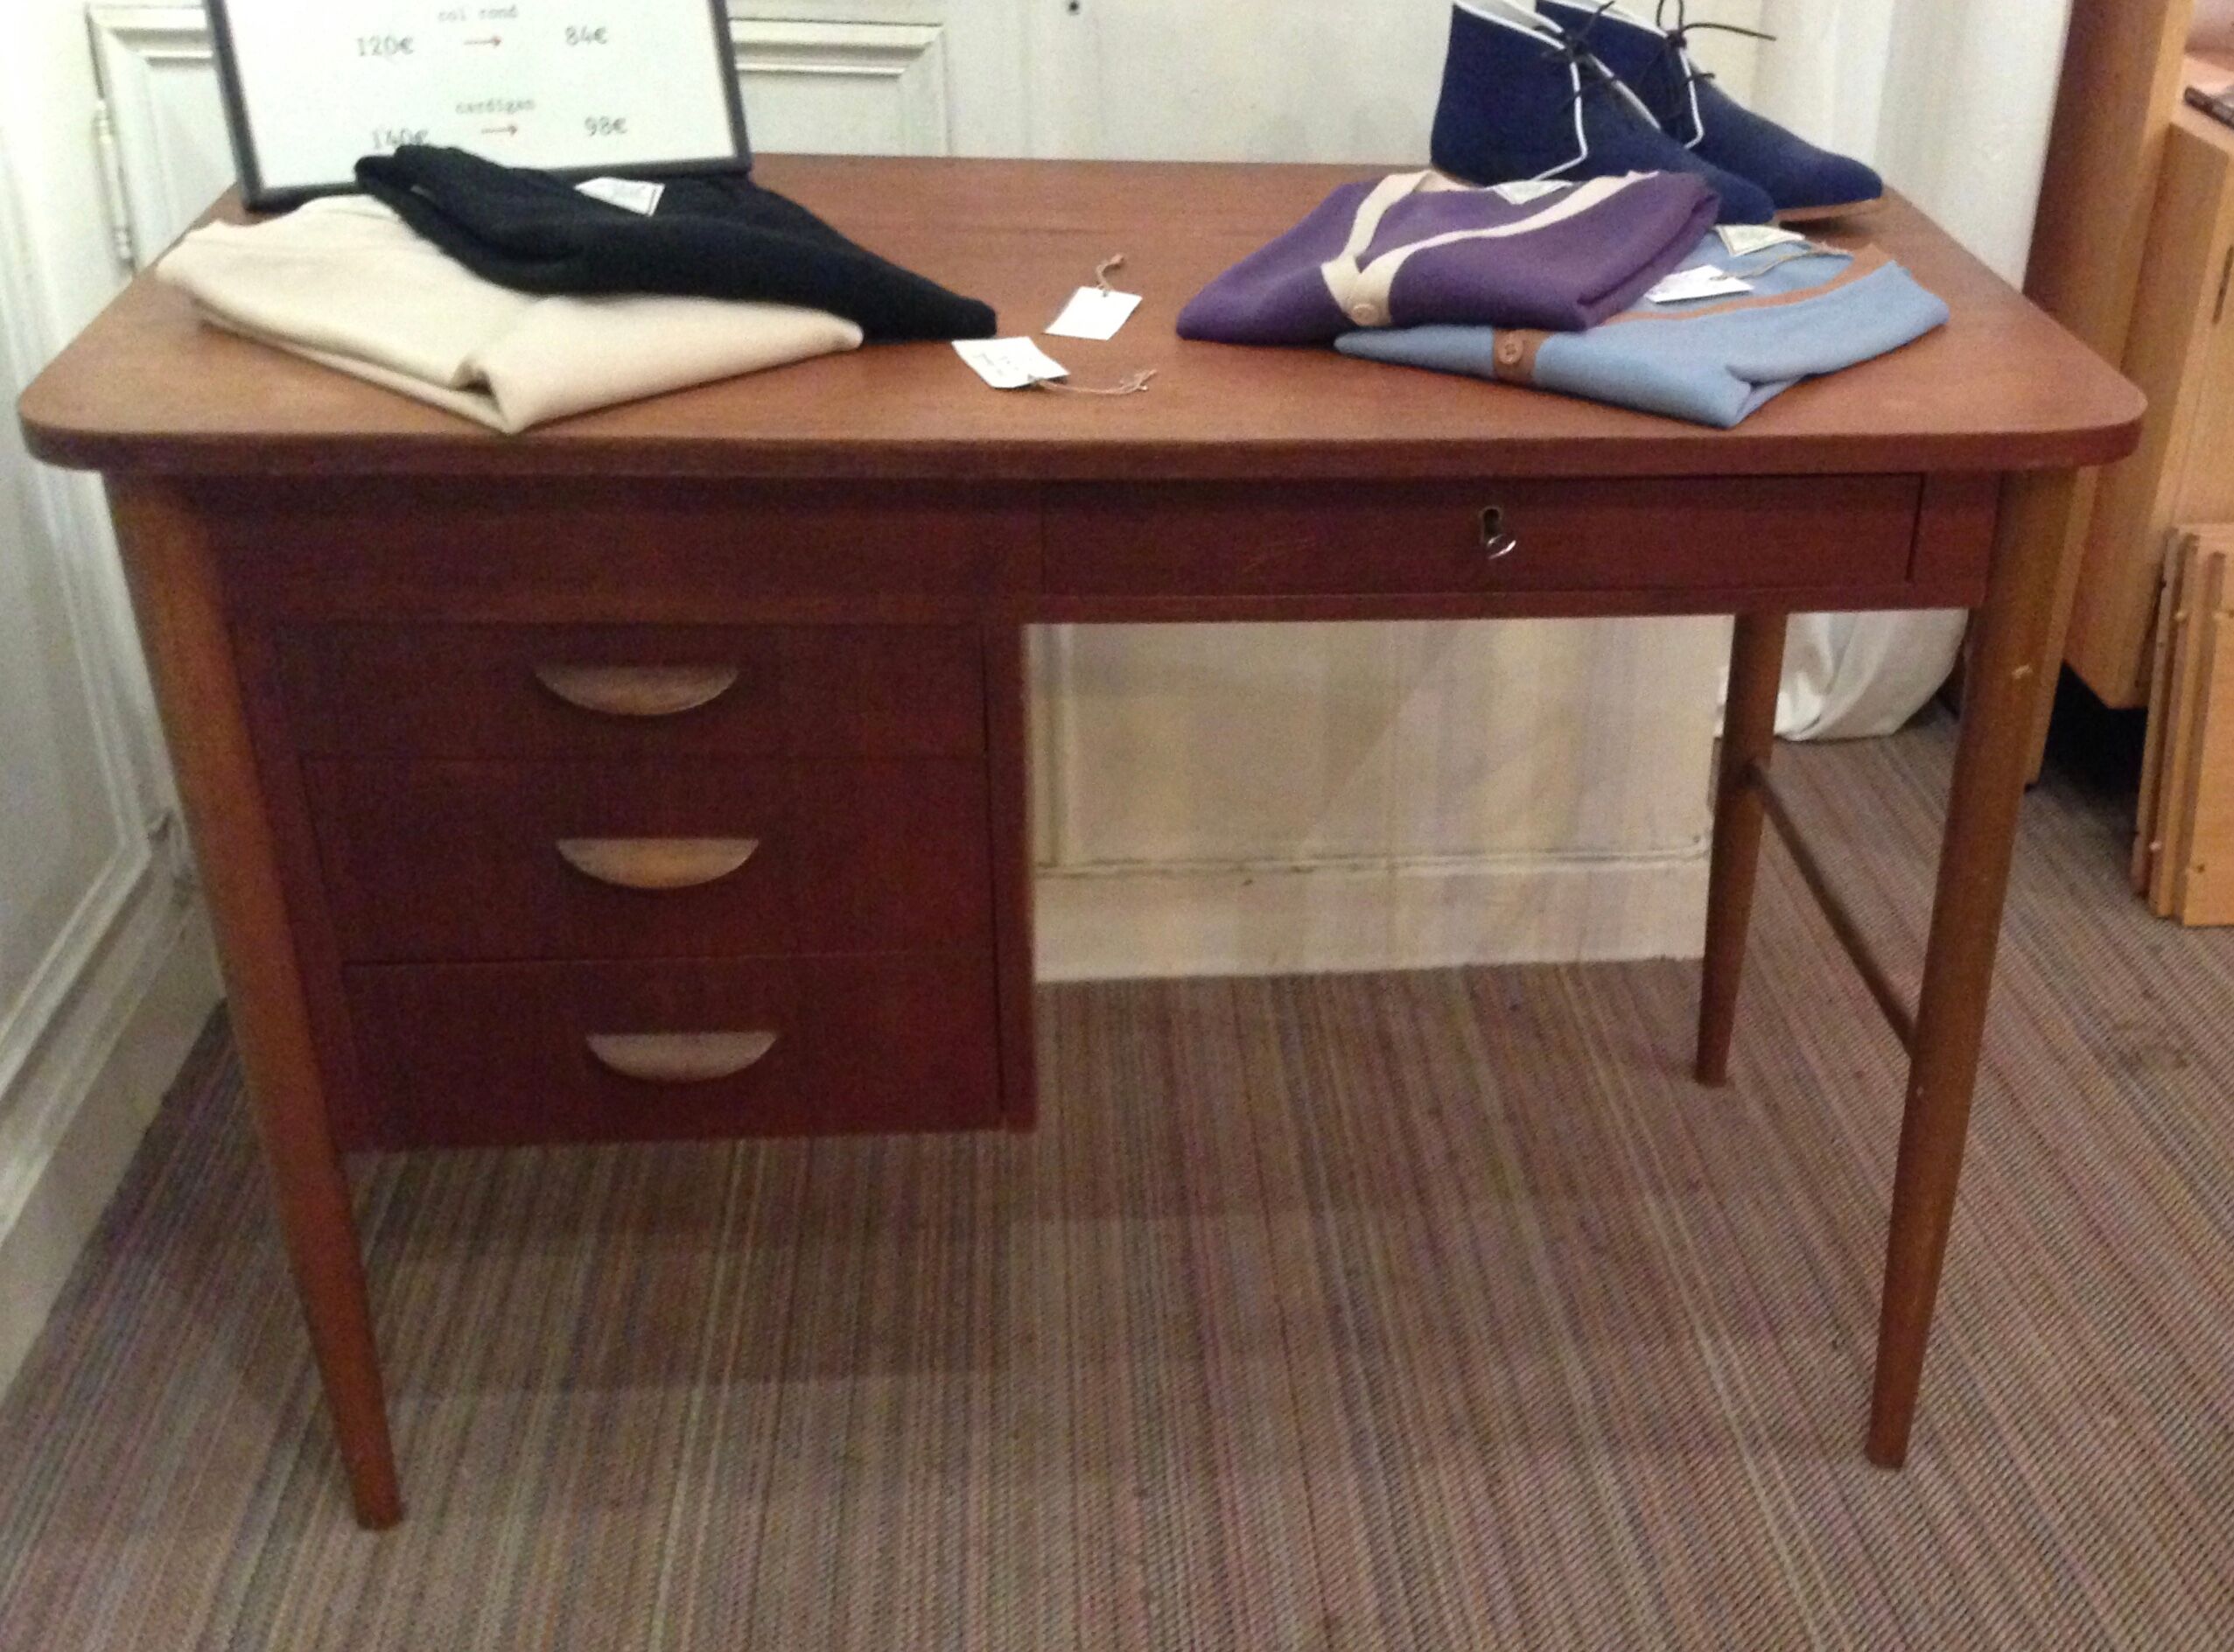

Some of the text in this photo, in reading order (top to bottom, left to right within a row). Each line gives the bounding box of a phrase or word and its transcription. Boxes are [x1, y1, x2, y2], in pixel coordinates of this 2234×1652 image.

[356, 25, 606, 57] 120€ 84€
[585, 116, 627, 136] 98€
